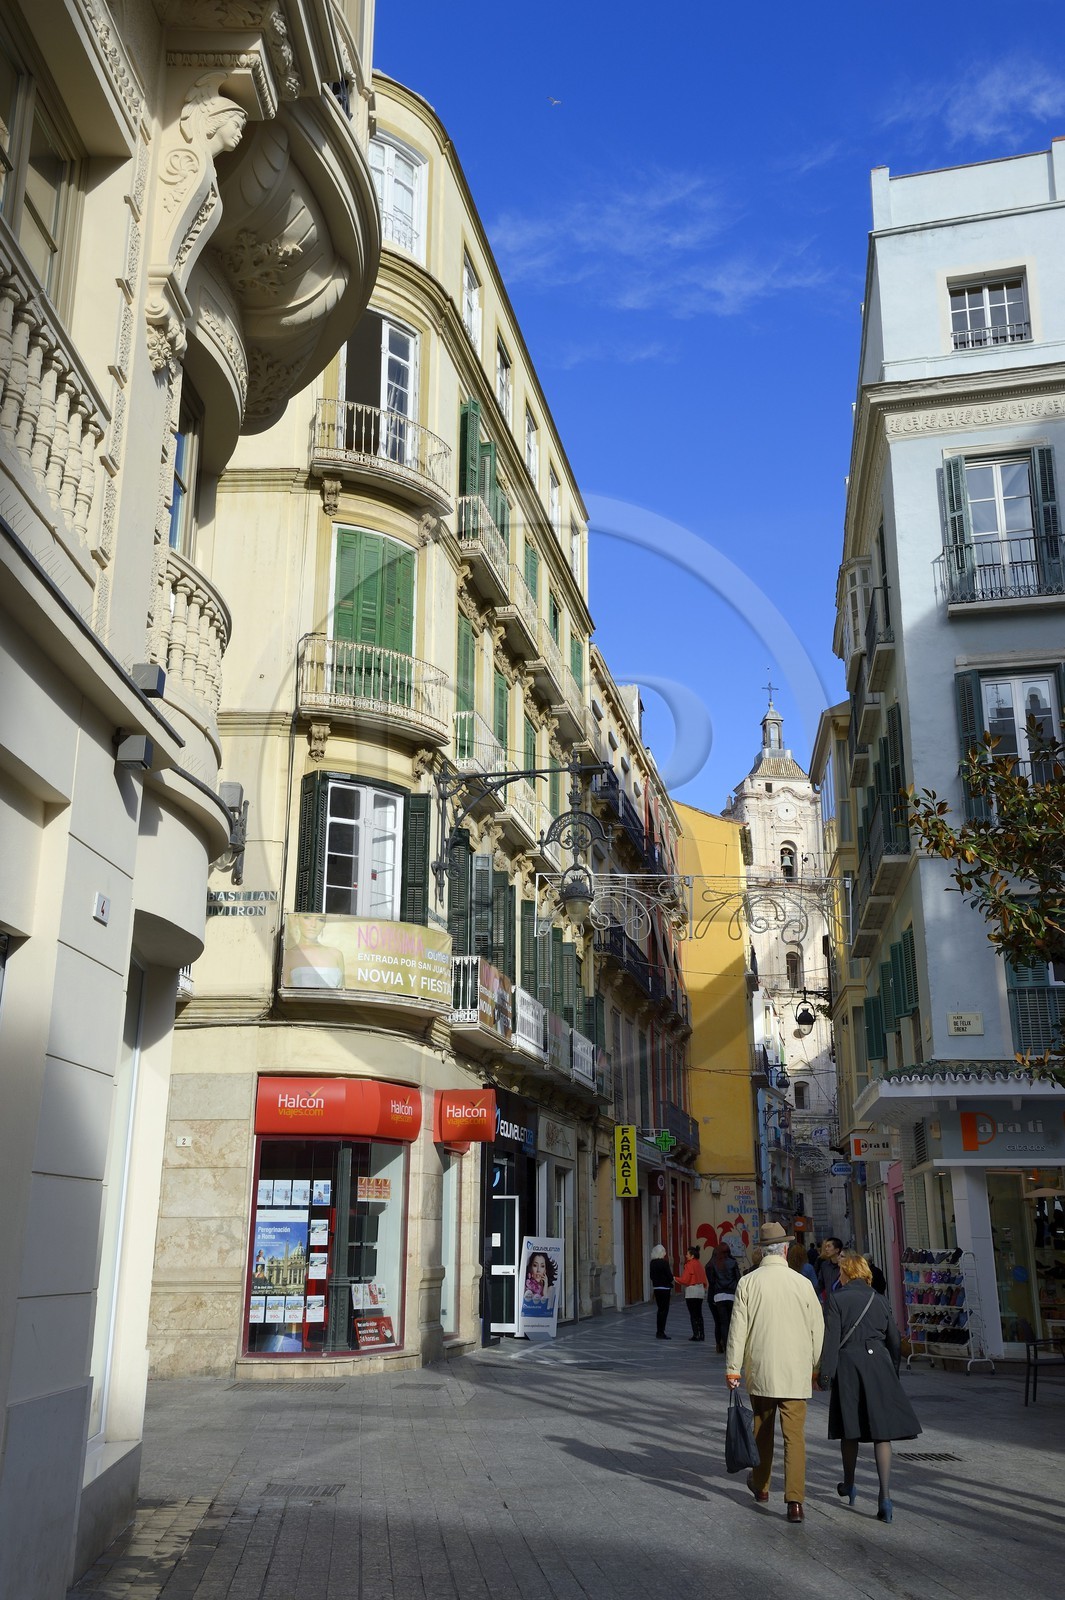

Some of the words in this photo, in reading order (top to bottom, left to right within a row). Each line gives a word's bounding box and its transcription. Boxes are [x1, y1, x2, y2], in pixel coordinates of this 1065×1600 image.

[357, 953, 399, 966] ENTRADA
[400, 957, 417, 968] POR
[418, 961, 431, 971] SAN
[357, 967, 403, 986] NOVIA
[408, 974, 416, 988] Y
[421, 976, 452, 995] FIESTA
[278, 1090, 324, 1109] Halcón
[390, 1097, 413, 1116] Halcón
[278, 1108, 323, 1118] viajes.com
[446, 1101, 487, 1118] Halcón
[1005, 1143, 1046, 1152] calzados
[619, 1128, 632, 1194] FARMACIA
[727, 1205, 758, 1214] Pollos
